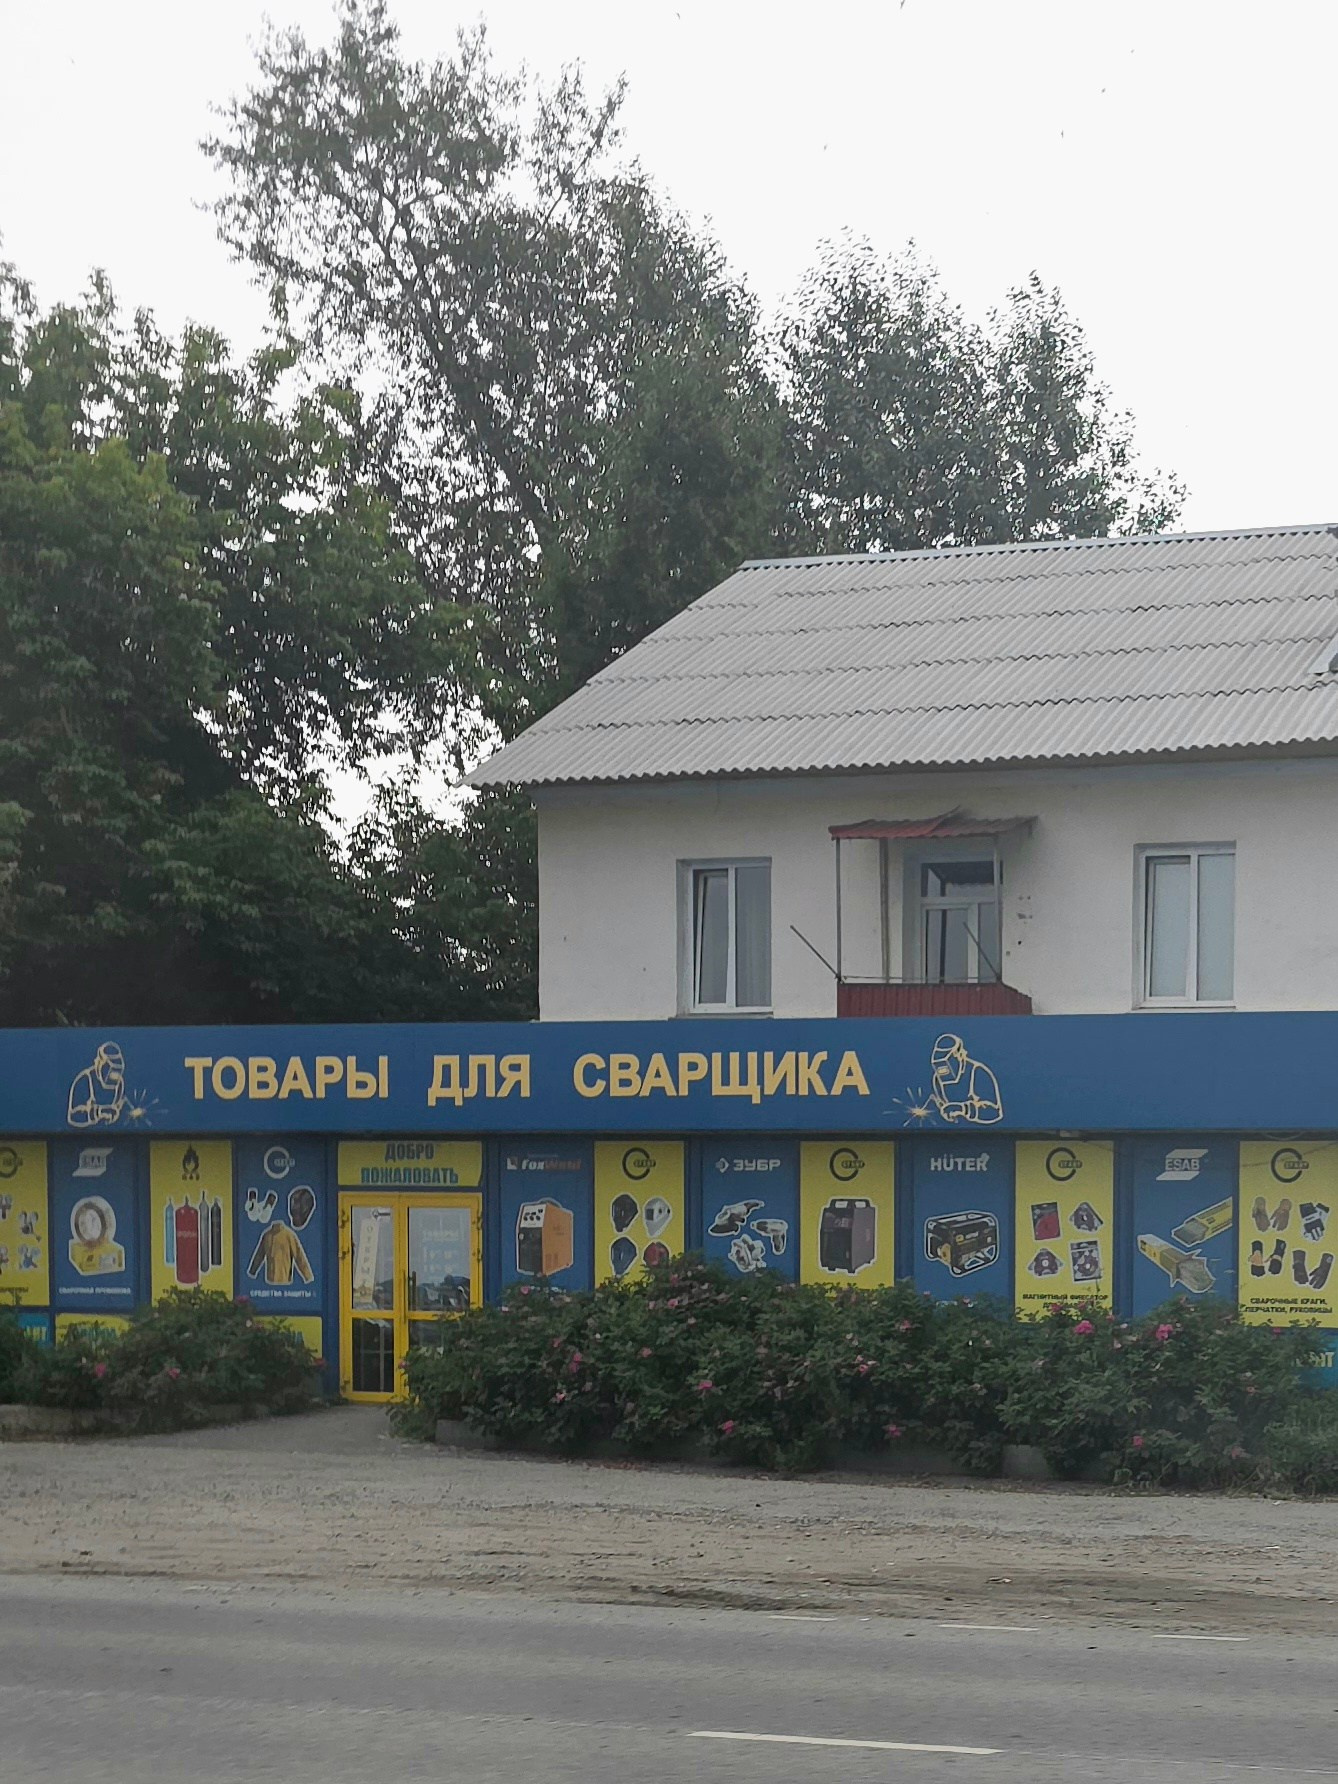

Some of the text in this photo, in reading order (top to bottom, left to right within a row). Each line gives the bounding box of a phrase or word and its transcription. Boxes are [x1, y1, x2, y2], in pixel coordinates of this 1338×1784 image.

[184, 1050, 870, 1106] ТОВАРЫ ДЛЯ СВАРЩИКА
[384, 1143, 435, 1162] ДОБРО
[733, 1159, 781, 1171] ЗУБР
[930, 1153, 989, 1171] HÜTER
[1165, 1158, 1200, 1171] ESAB
[360, 1167, 459, 1184] ПОЖАЛОВАТЬ
